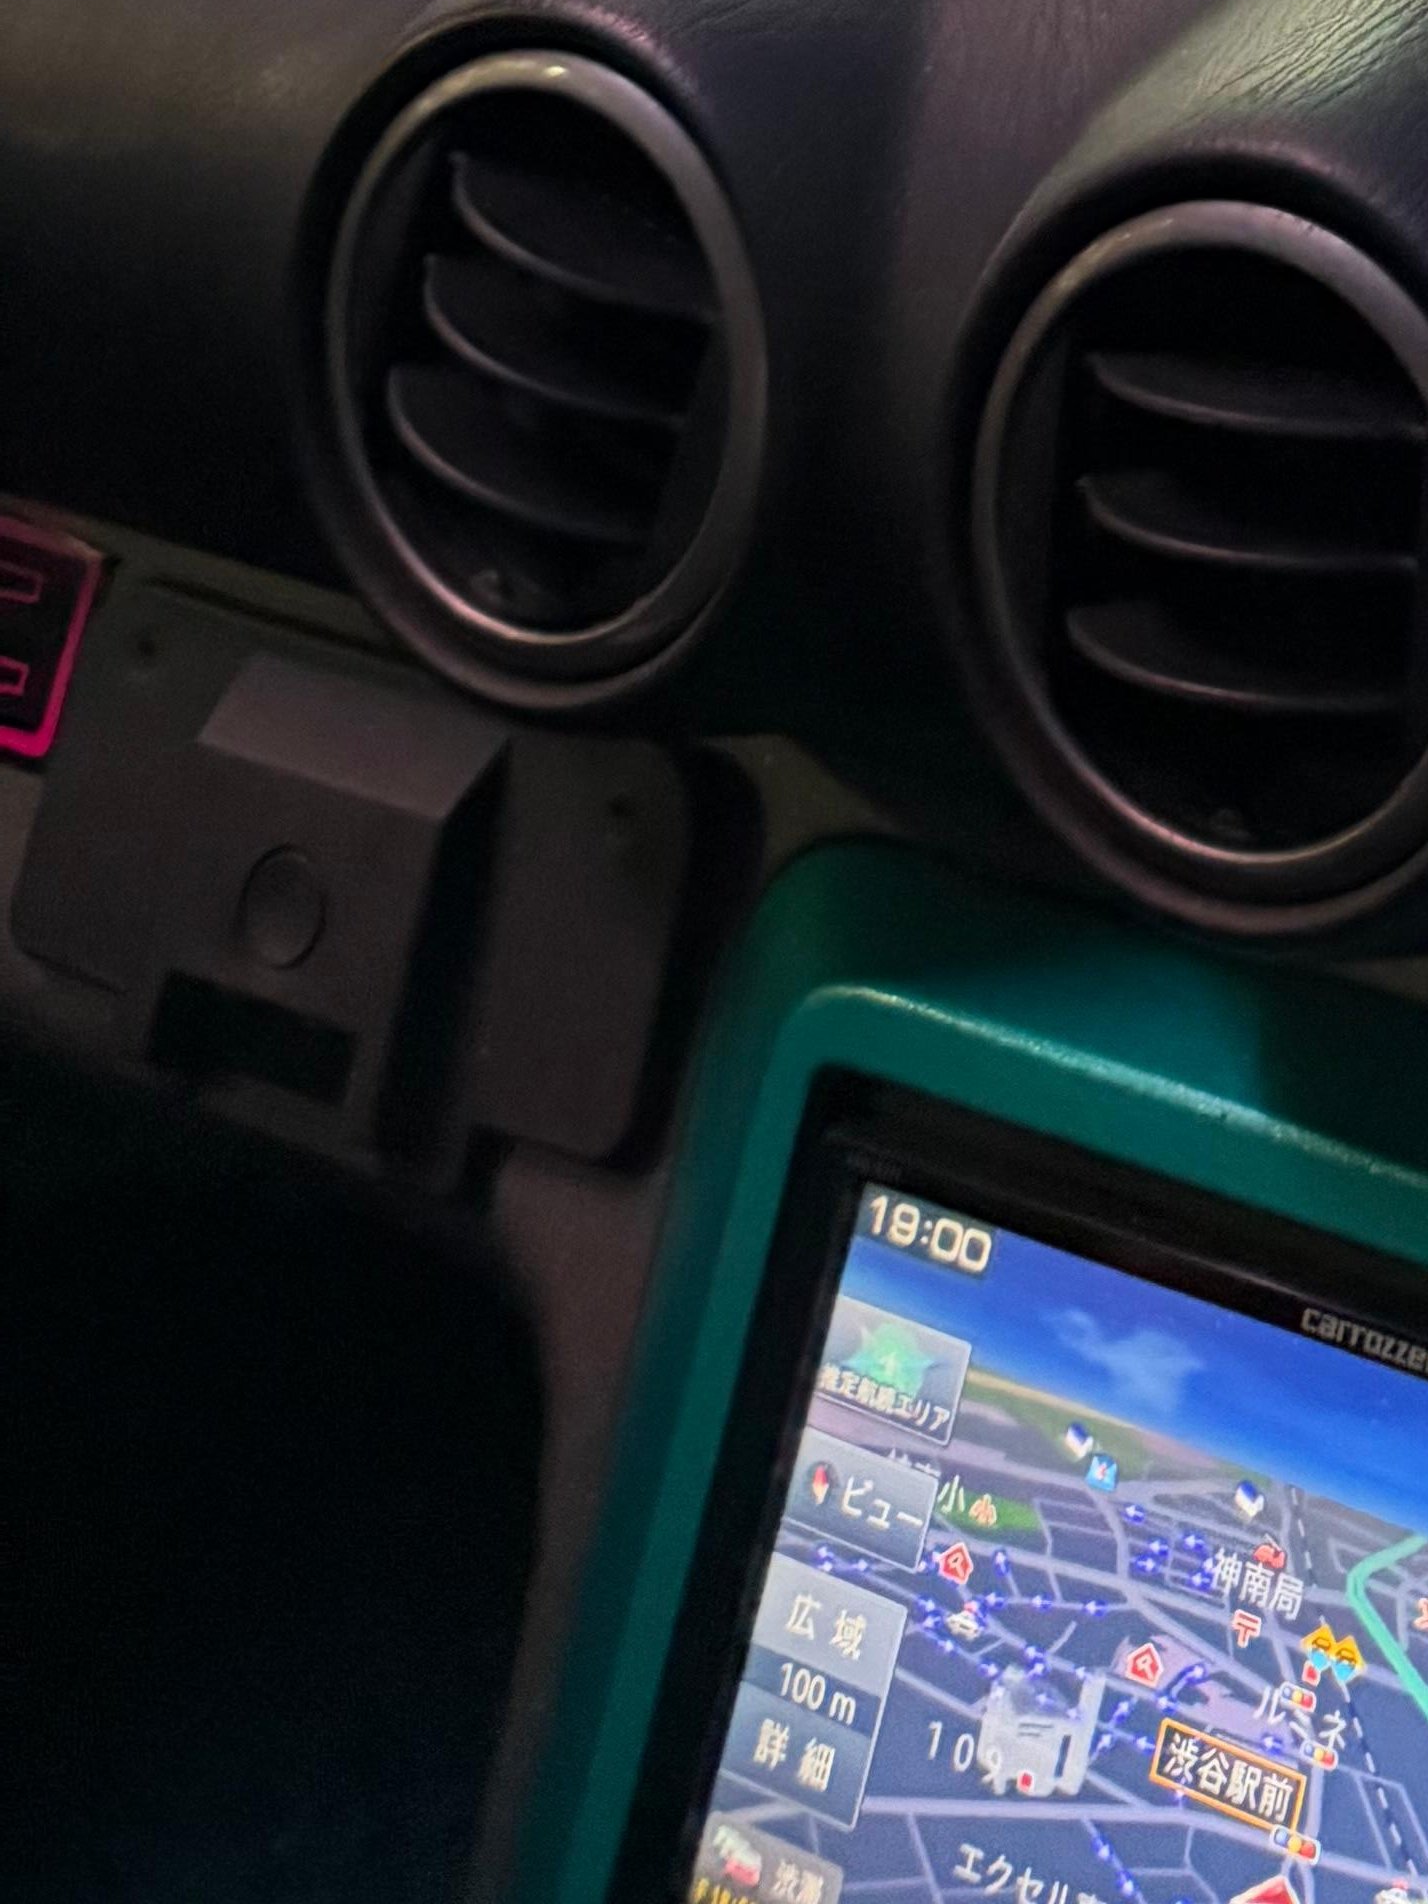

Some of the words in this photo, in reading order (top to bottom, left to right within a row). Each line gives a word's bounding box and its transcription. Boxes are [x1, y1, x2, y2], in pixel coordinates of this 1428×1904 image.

[869, 1194, 992, 1274] 19:00
[841, 1475, 924, 1530] ビュー
[1211, 1546, 1304, 1622] 神南局
[779, 1661, 826, 1712] 100
[828, 1688, 857, 1726] m
[1162, 1731, 1294, 1824] 渋谷駅前
